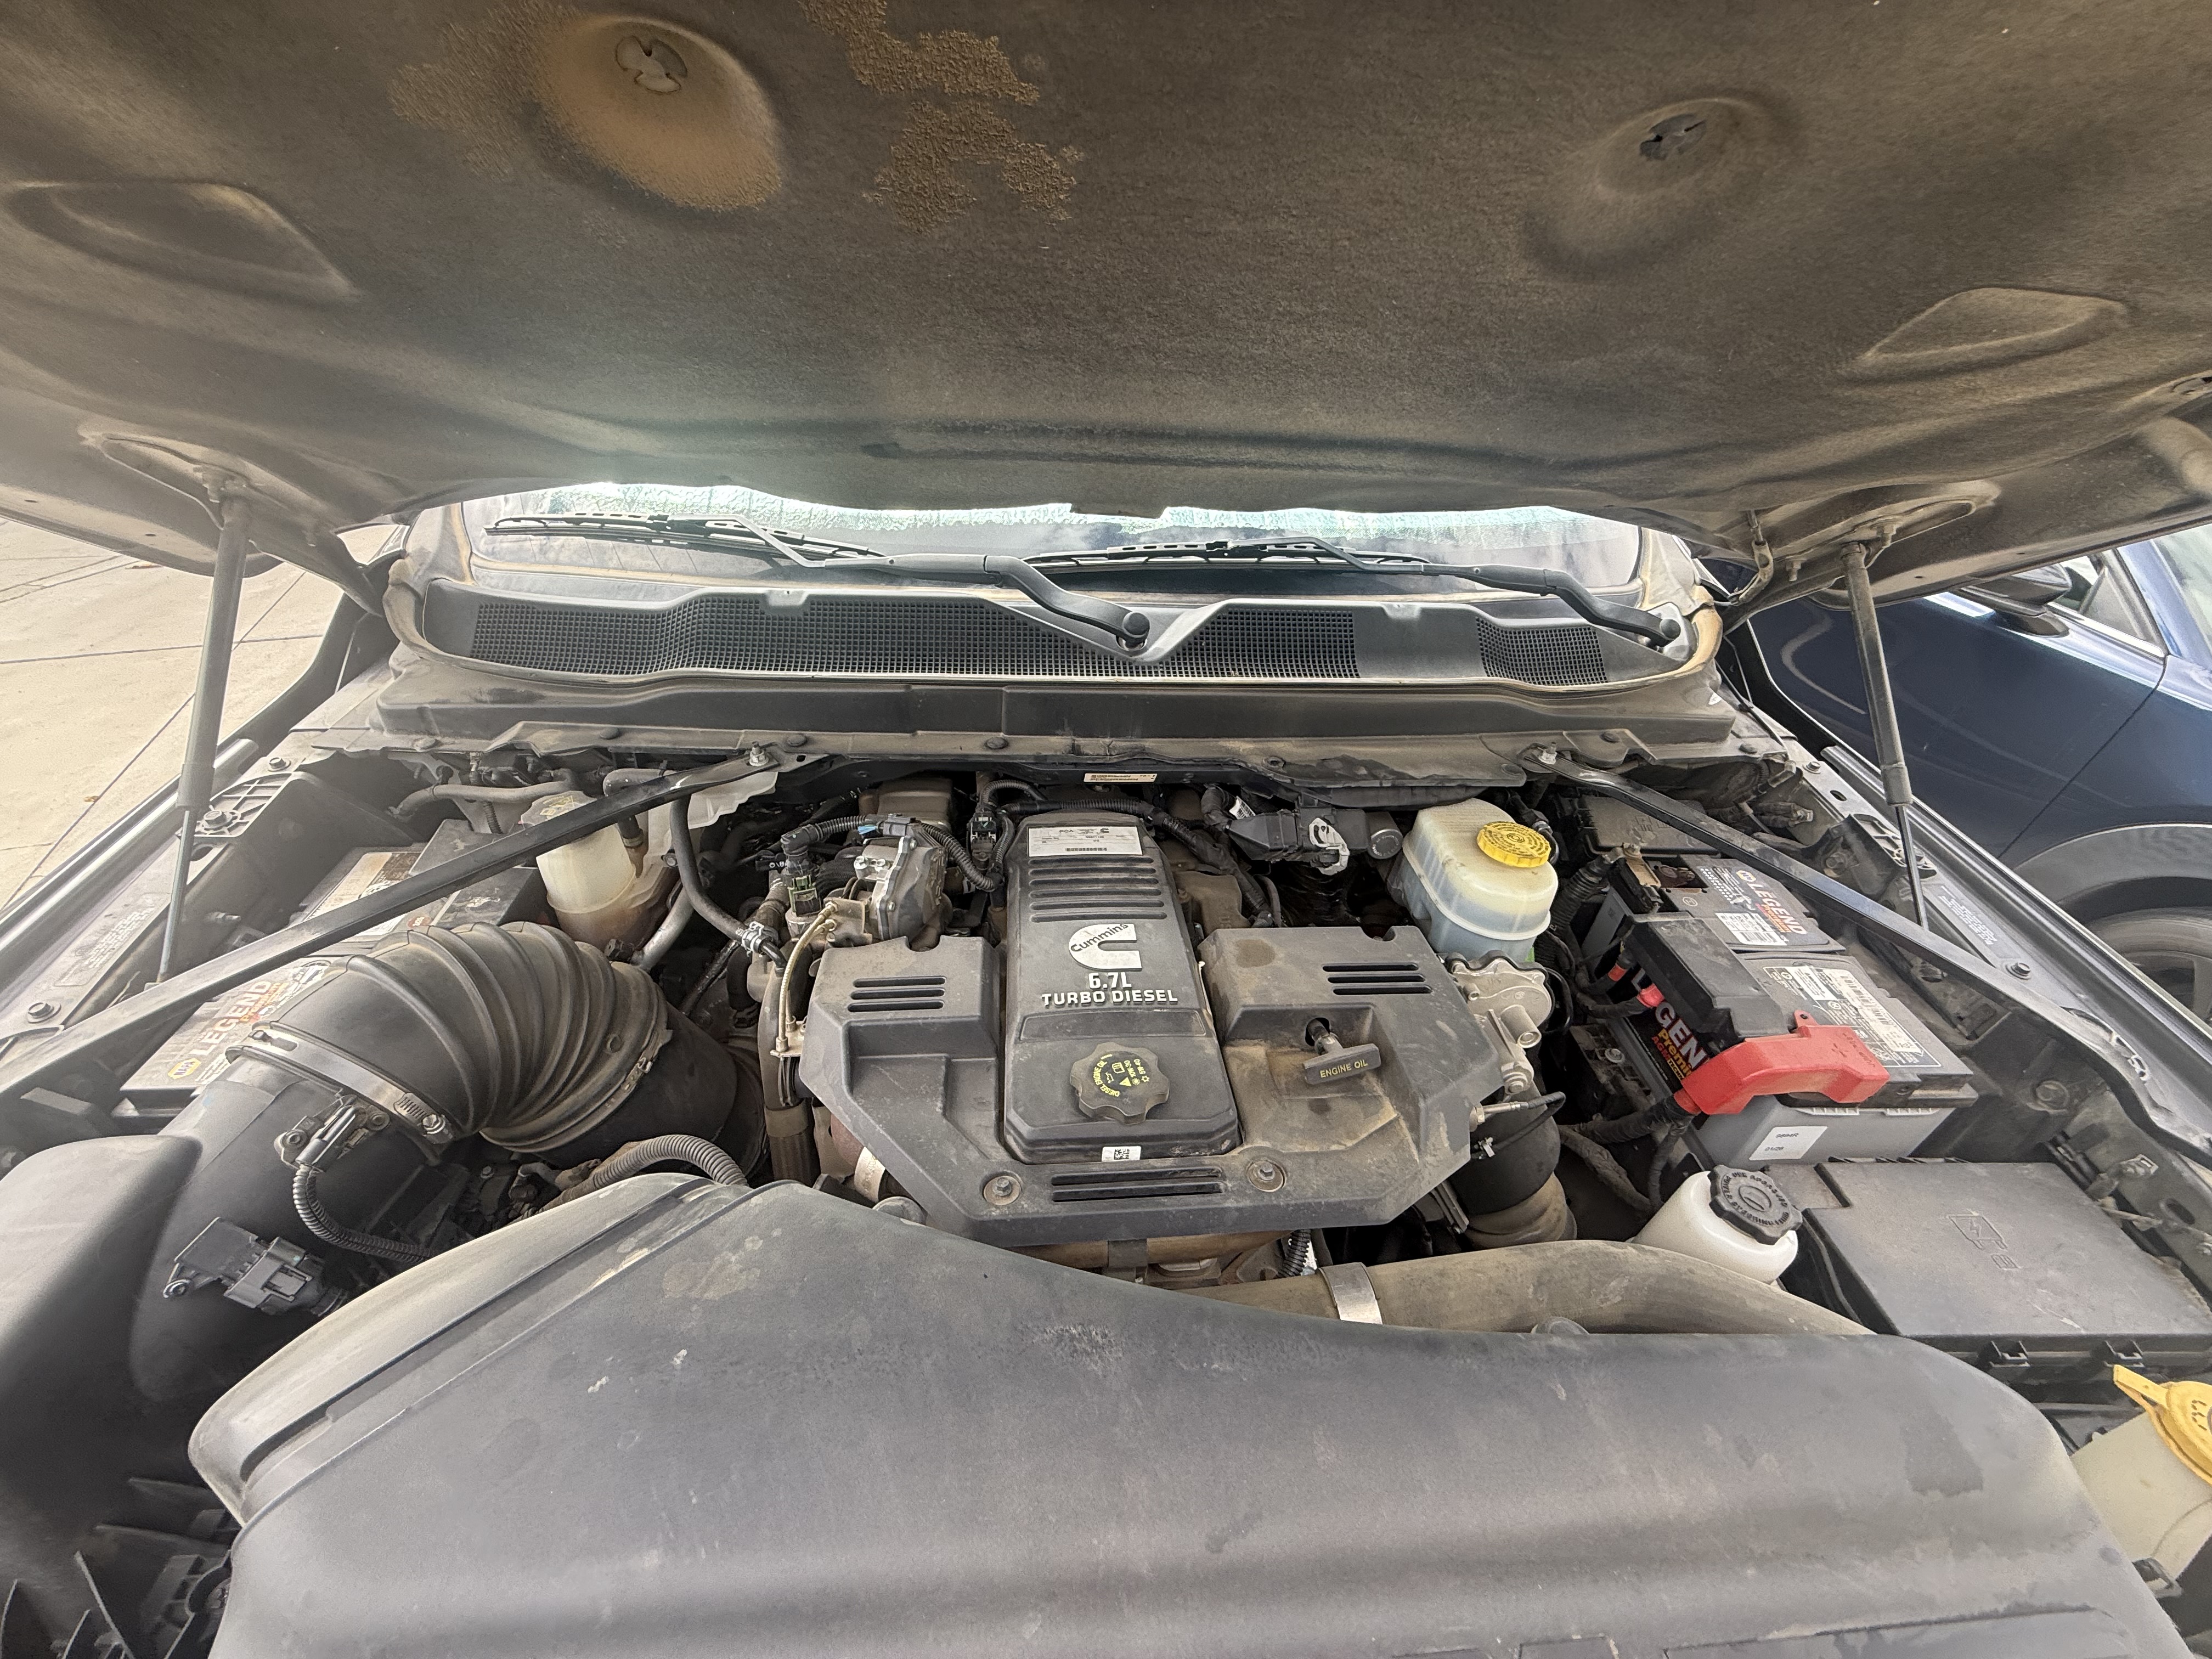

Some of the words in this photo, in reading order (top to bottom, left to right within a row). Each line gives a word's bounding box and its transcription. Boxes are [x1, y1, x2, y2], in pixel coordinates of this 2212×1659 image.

[1747, 882, 1807, 935] LEGEND
[1070, 923, 1128, 952] Cummins
[1088, 972, 1132, 989] 6.7L
[1041, 990, 1105, 1006] TURBO
[1111, 989, 1178, 1003] DIESEL
[190, 981, 273, 1056] LEGEND
[174, 1061, 195, 1076] NAPA
[1093, 1066, 1103, 1086] ENGINE
[1124, 1060, 1136, 1078] 10W-30
[1133, 1059, 1146, 1075] 5W-40
[1319, 1063, 1352, 1078] ENGINE
[1354, 1059, 1368, 1069] OIL
[1100, 1084, 1120, 1097] DIESEL
